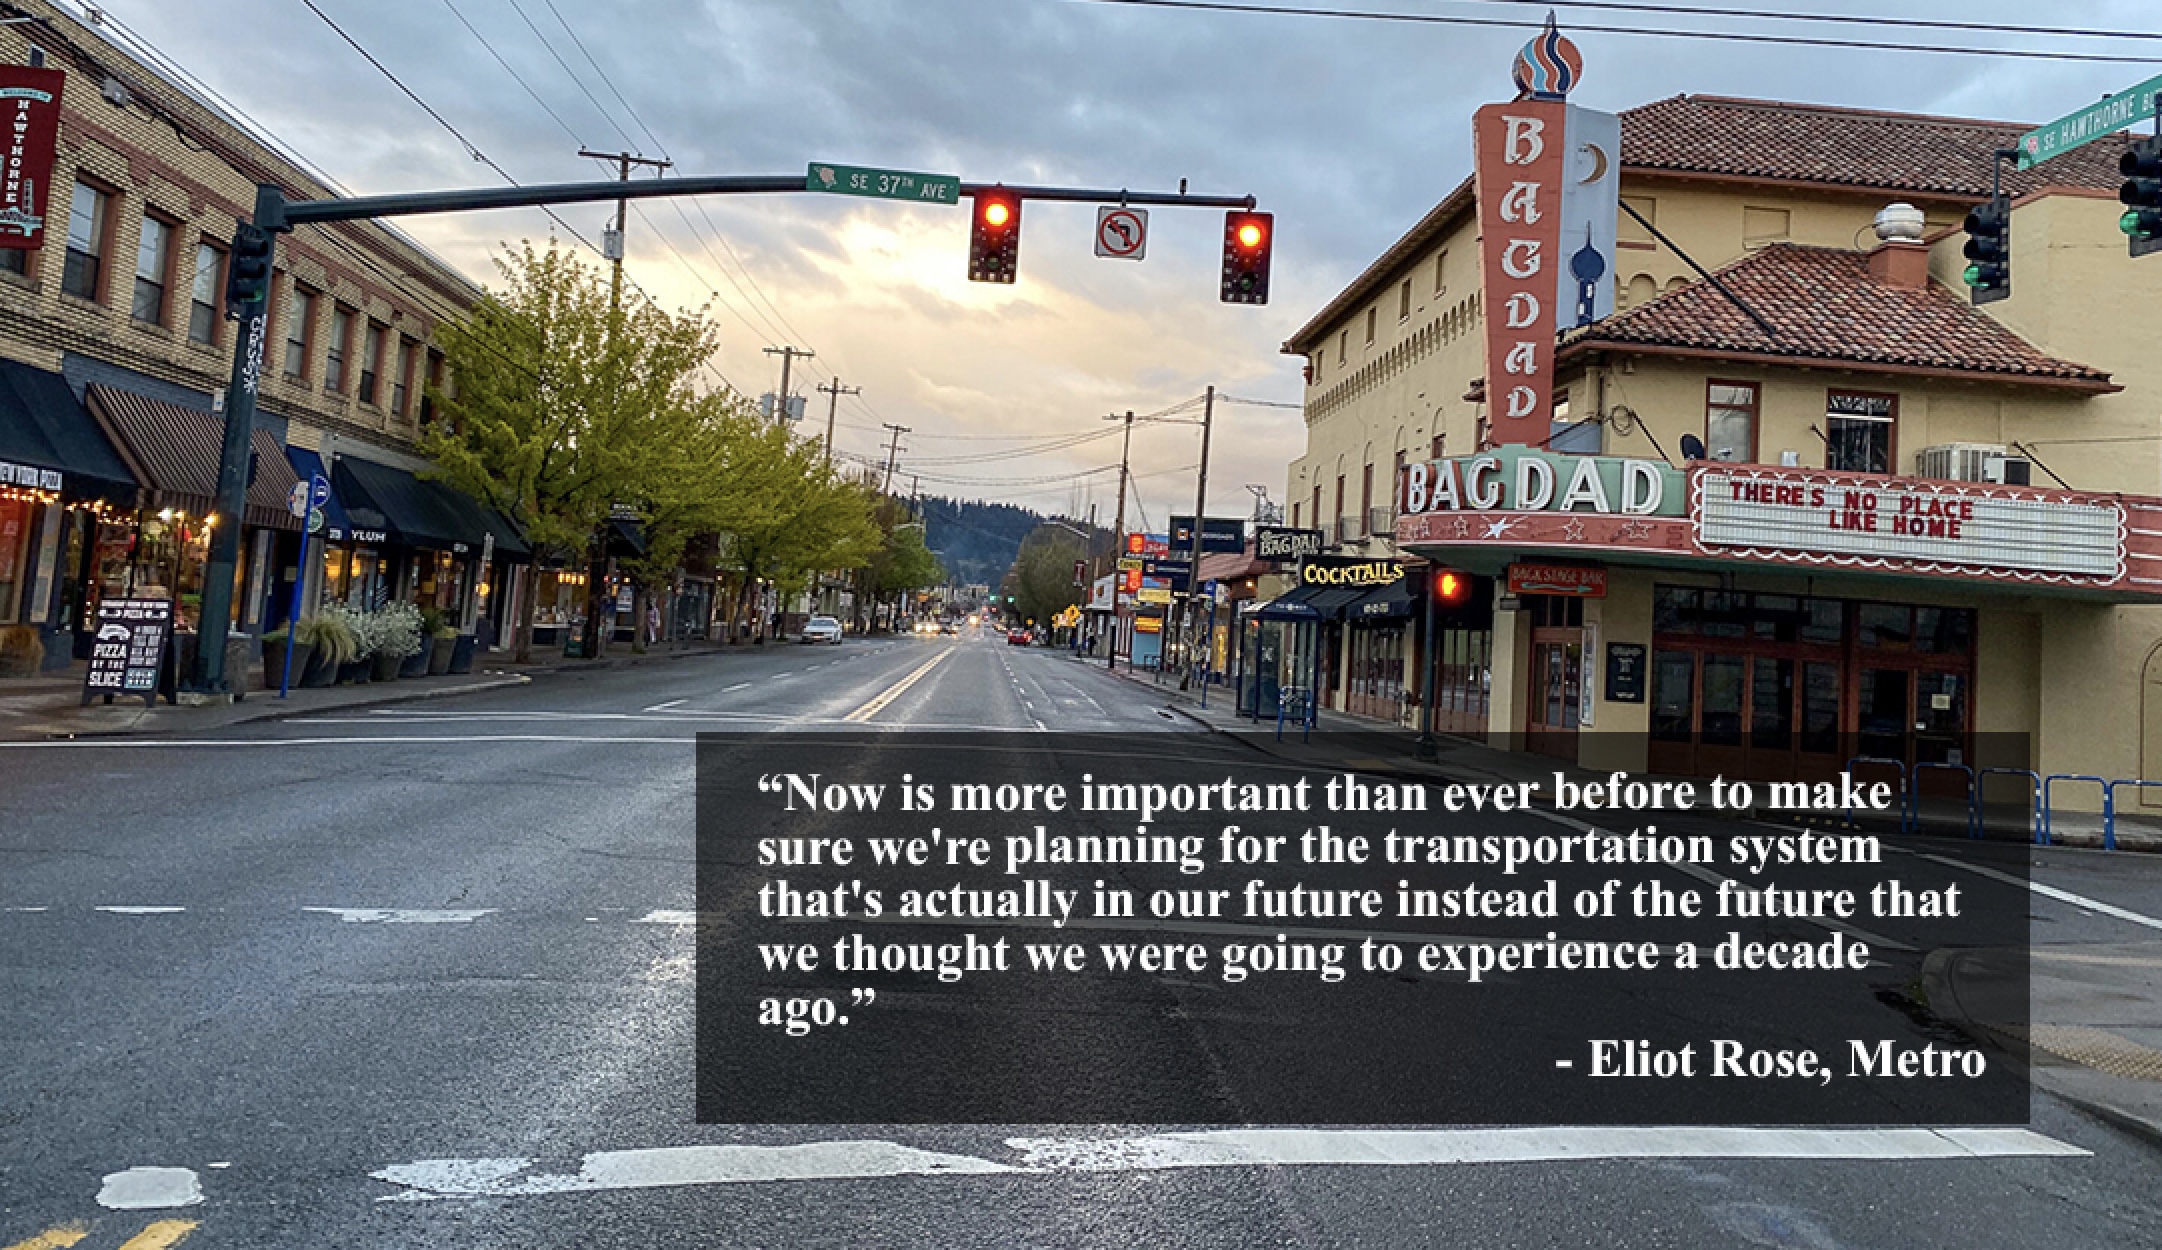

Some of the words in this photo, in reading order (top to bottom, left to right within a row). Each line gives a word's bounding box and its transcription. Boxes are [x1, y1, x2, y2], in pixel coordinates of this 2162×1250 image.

[2043, 131, 2056, 151] SE
[2060, 93, 2136, 147] HAWTHORNE
[5, 99, 30, 203] HAWTHORNE
[850, 173, 869, 190] SE
[919, 183, 947, 199] AVE
[1501, 115, 1545, 417] BAGDAD
[1404, 457, 1663, 515] BAGDAD
[1844, 491, 1877, 511] NO
[1900, 495, 1974, 520] PLACE
[1829, 509, 1878, 532] LIKE
[1892, 515, 1962, 539] HOME
[1304, 562, 1405, 585] COCKTAILS
[93, 643, 127, 659] PIZZA
[88, 671, 123, 687] SLICE
